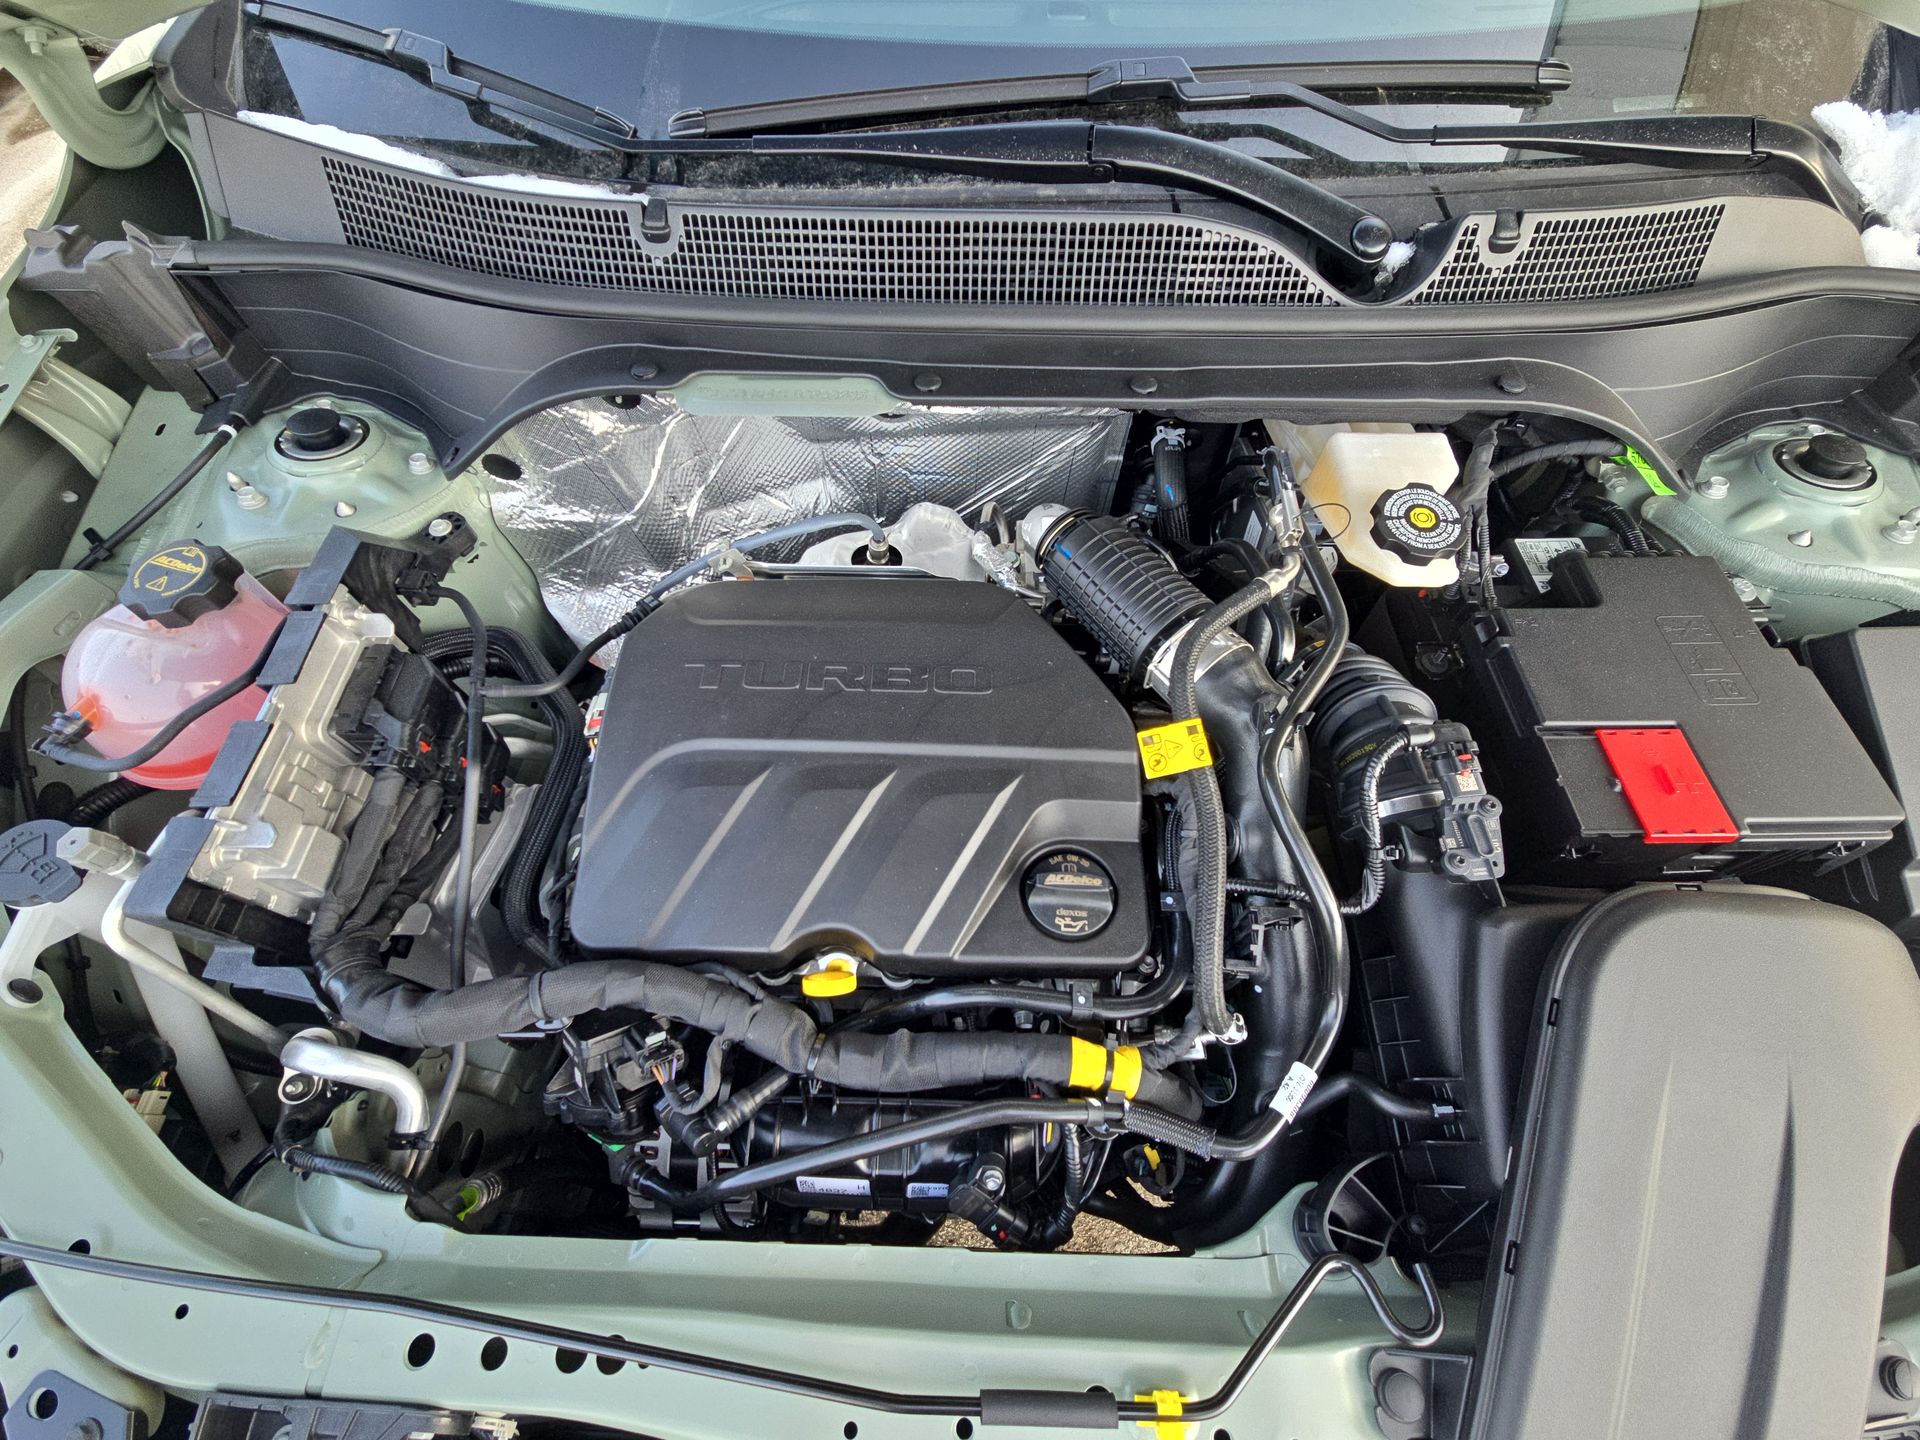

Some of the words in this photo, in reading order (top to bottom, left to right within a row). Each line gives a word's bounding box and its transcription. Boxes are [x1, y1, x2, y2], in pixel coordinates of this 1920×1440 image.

[684, 660, 993, 695] TURBO
[1048, 854, 1064, 865] SAE
[1045, 873, 1102, 886] ACDelco
[1056, 908, 1088, 917] dexos
